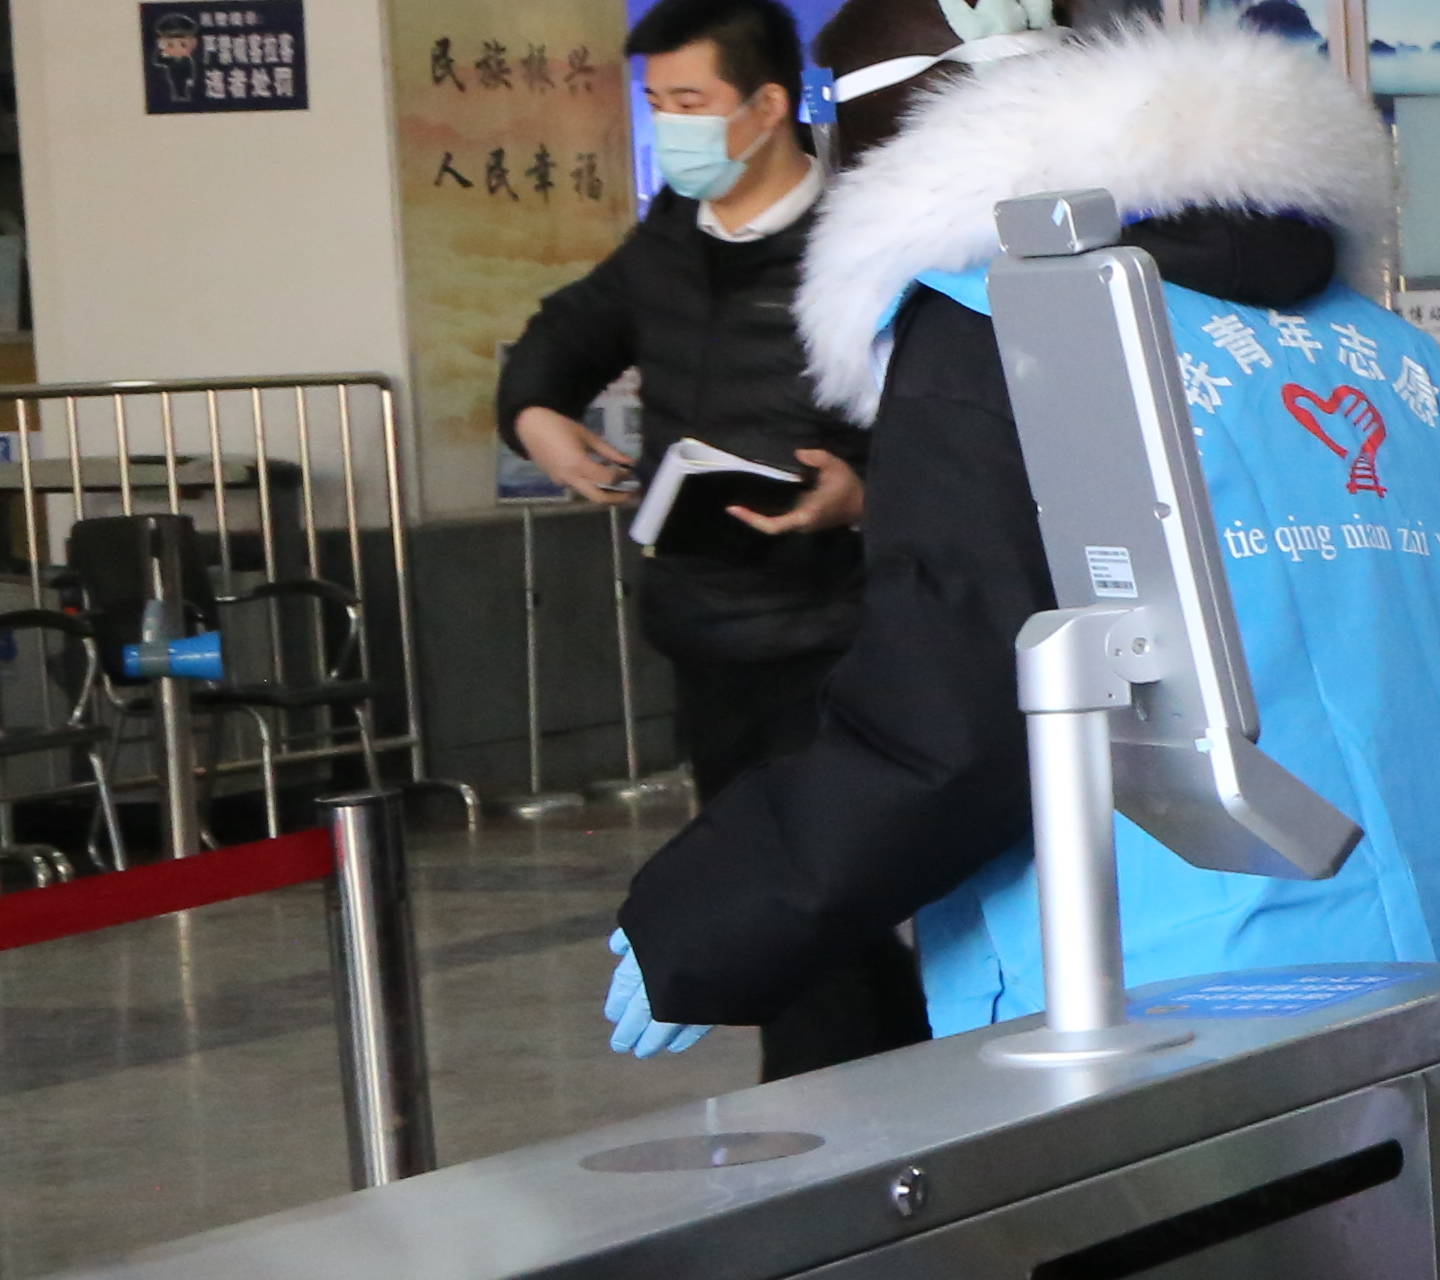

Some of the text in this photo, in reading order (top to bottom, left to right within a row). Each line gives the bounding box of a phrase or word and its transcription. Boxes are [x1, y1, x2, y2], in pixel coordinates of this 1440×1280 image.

[431, 37, 596, 95] 民族振兴
[434, 142, 604, 202] 人民幸福
[1224, 519, 1268, 560] tie
[1275, 515, 1338, 563] qing
[1341, 513, 1393, 551] nian
